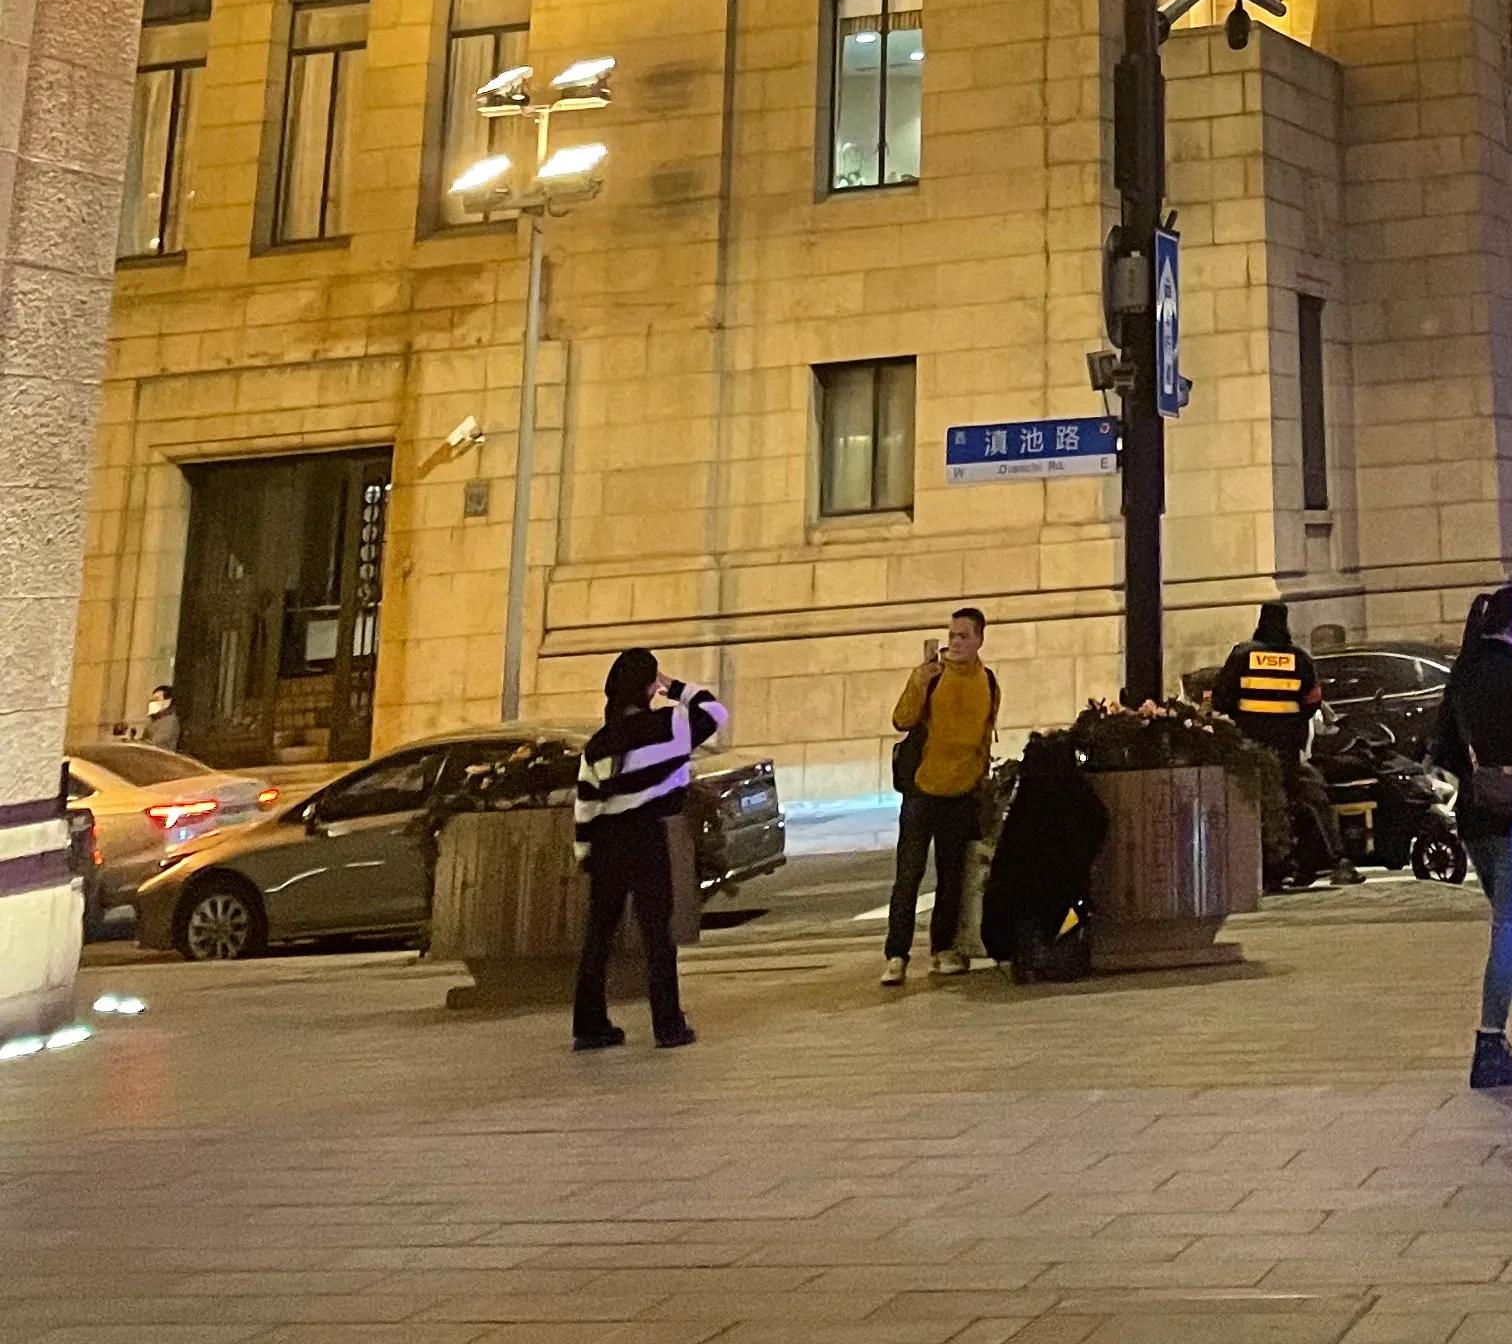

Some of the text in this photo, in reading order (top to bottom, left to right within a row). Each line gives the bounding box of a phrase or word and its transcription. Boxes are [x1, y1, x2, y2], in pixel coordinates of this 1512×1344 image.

[984, 424, 1081, 457] 滇池路
[953, 467, 966, 480] W
[1101, 456, 1110, 469] E
[1255, 655, 1291, 667] VSP
